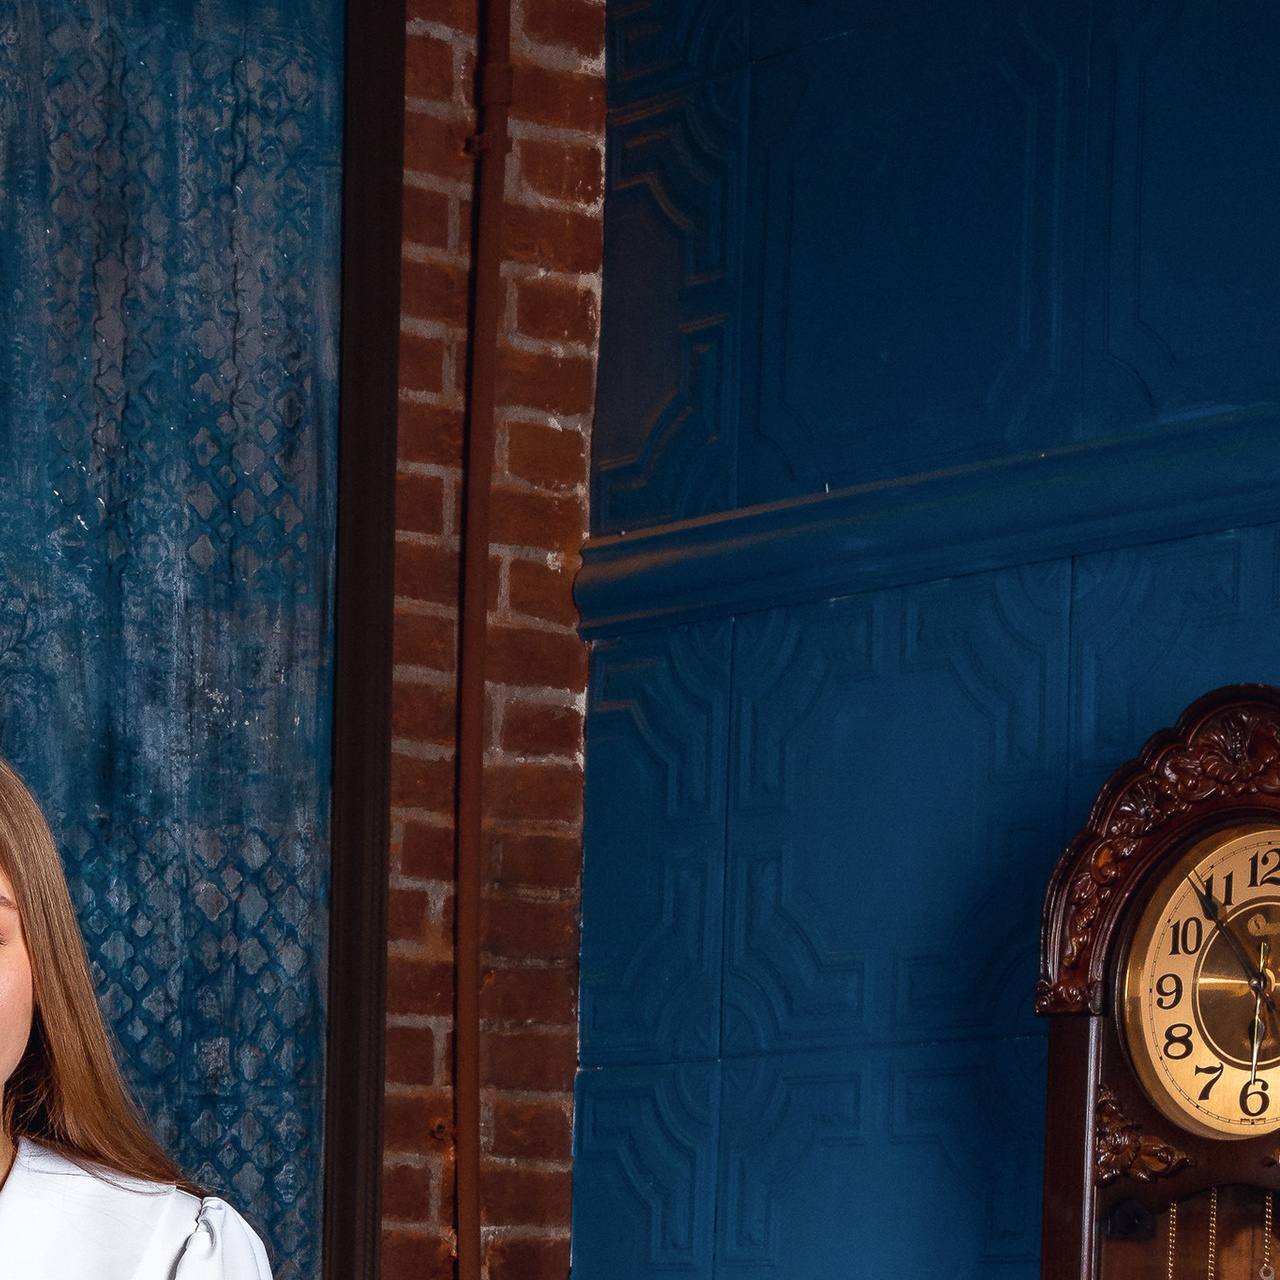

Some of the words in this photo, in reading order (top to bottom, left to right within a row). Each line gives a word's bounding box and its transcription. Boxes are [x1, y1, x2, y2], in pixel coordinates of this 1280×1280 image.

[1247, 848, 1280, 888] 12
[1204, 870, 1235, 907] 11
[1168, 917, 1203, 956] 10
[1156, 974, 1183, 1010] 9
[1164, 1023, 1194, 1060] 8
[1195, 1062, 1224, 1101] 7
[1239, 1078, 1270, 1117] 6
